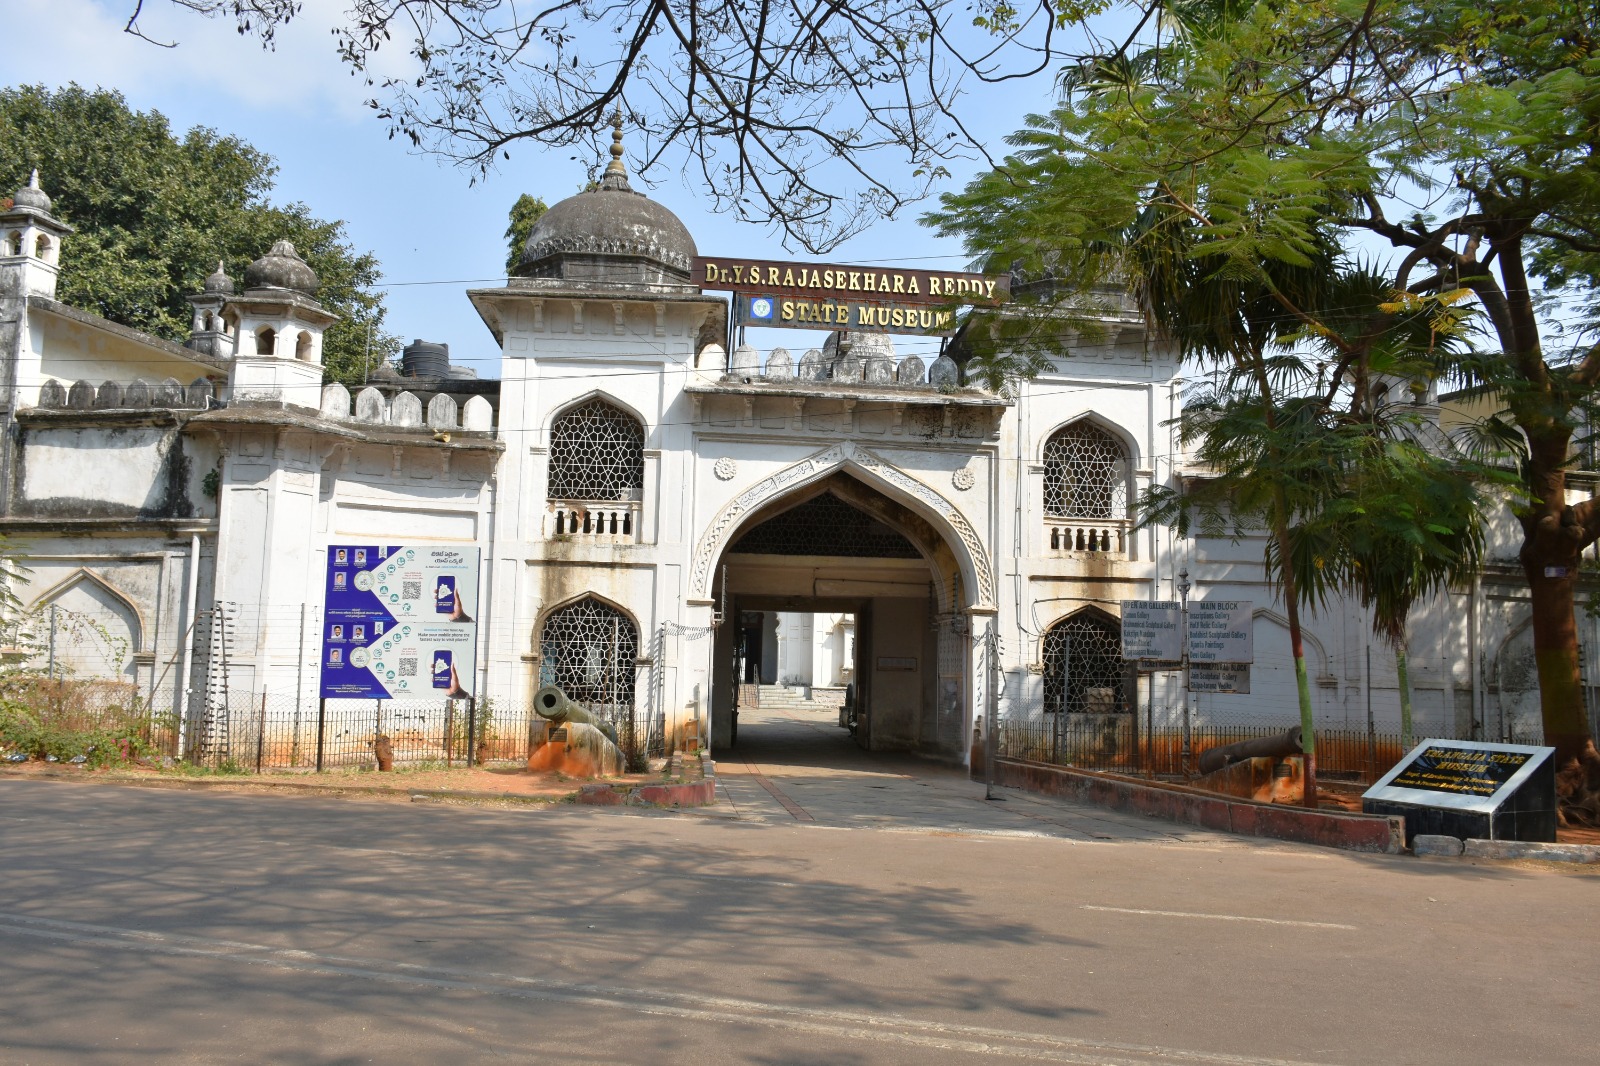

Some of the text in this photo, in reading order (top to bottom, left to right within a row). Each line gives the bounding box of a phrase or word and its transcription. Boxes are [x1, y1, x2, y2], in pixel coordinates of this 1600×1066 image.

[929, 276, 996, 299] REDDY
[782, 301, 952, 330] STATE MUSEUM
[1124, 601, 1137, 609] OPEN
[1149, 602, 1178, 610] GALLERIES
[1200, 602, 1238, 611] MAIN BLOCK
[1214, 612, 1230, 620] Gallery
[1211, 621, 1227, 630] Gallery
[1208, 631, 1230, 640] Sculptural
[1230, 631, 1247, 640] Gallery
[1204, 640, 1225, 650] Paintings
[1200, 652, 1216, 660] Gallery
[1230, 664, 1247, 672] BLOCK
[1190, 672, 1237, 682] Jain Sculptural Gallery
[1424, 749, 1525, 765] TELANGANA STATE
[1435, 761, 1490, 773] MUSEUM
